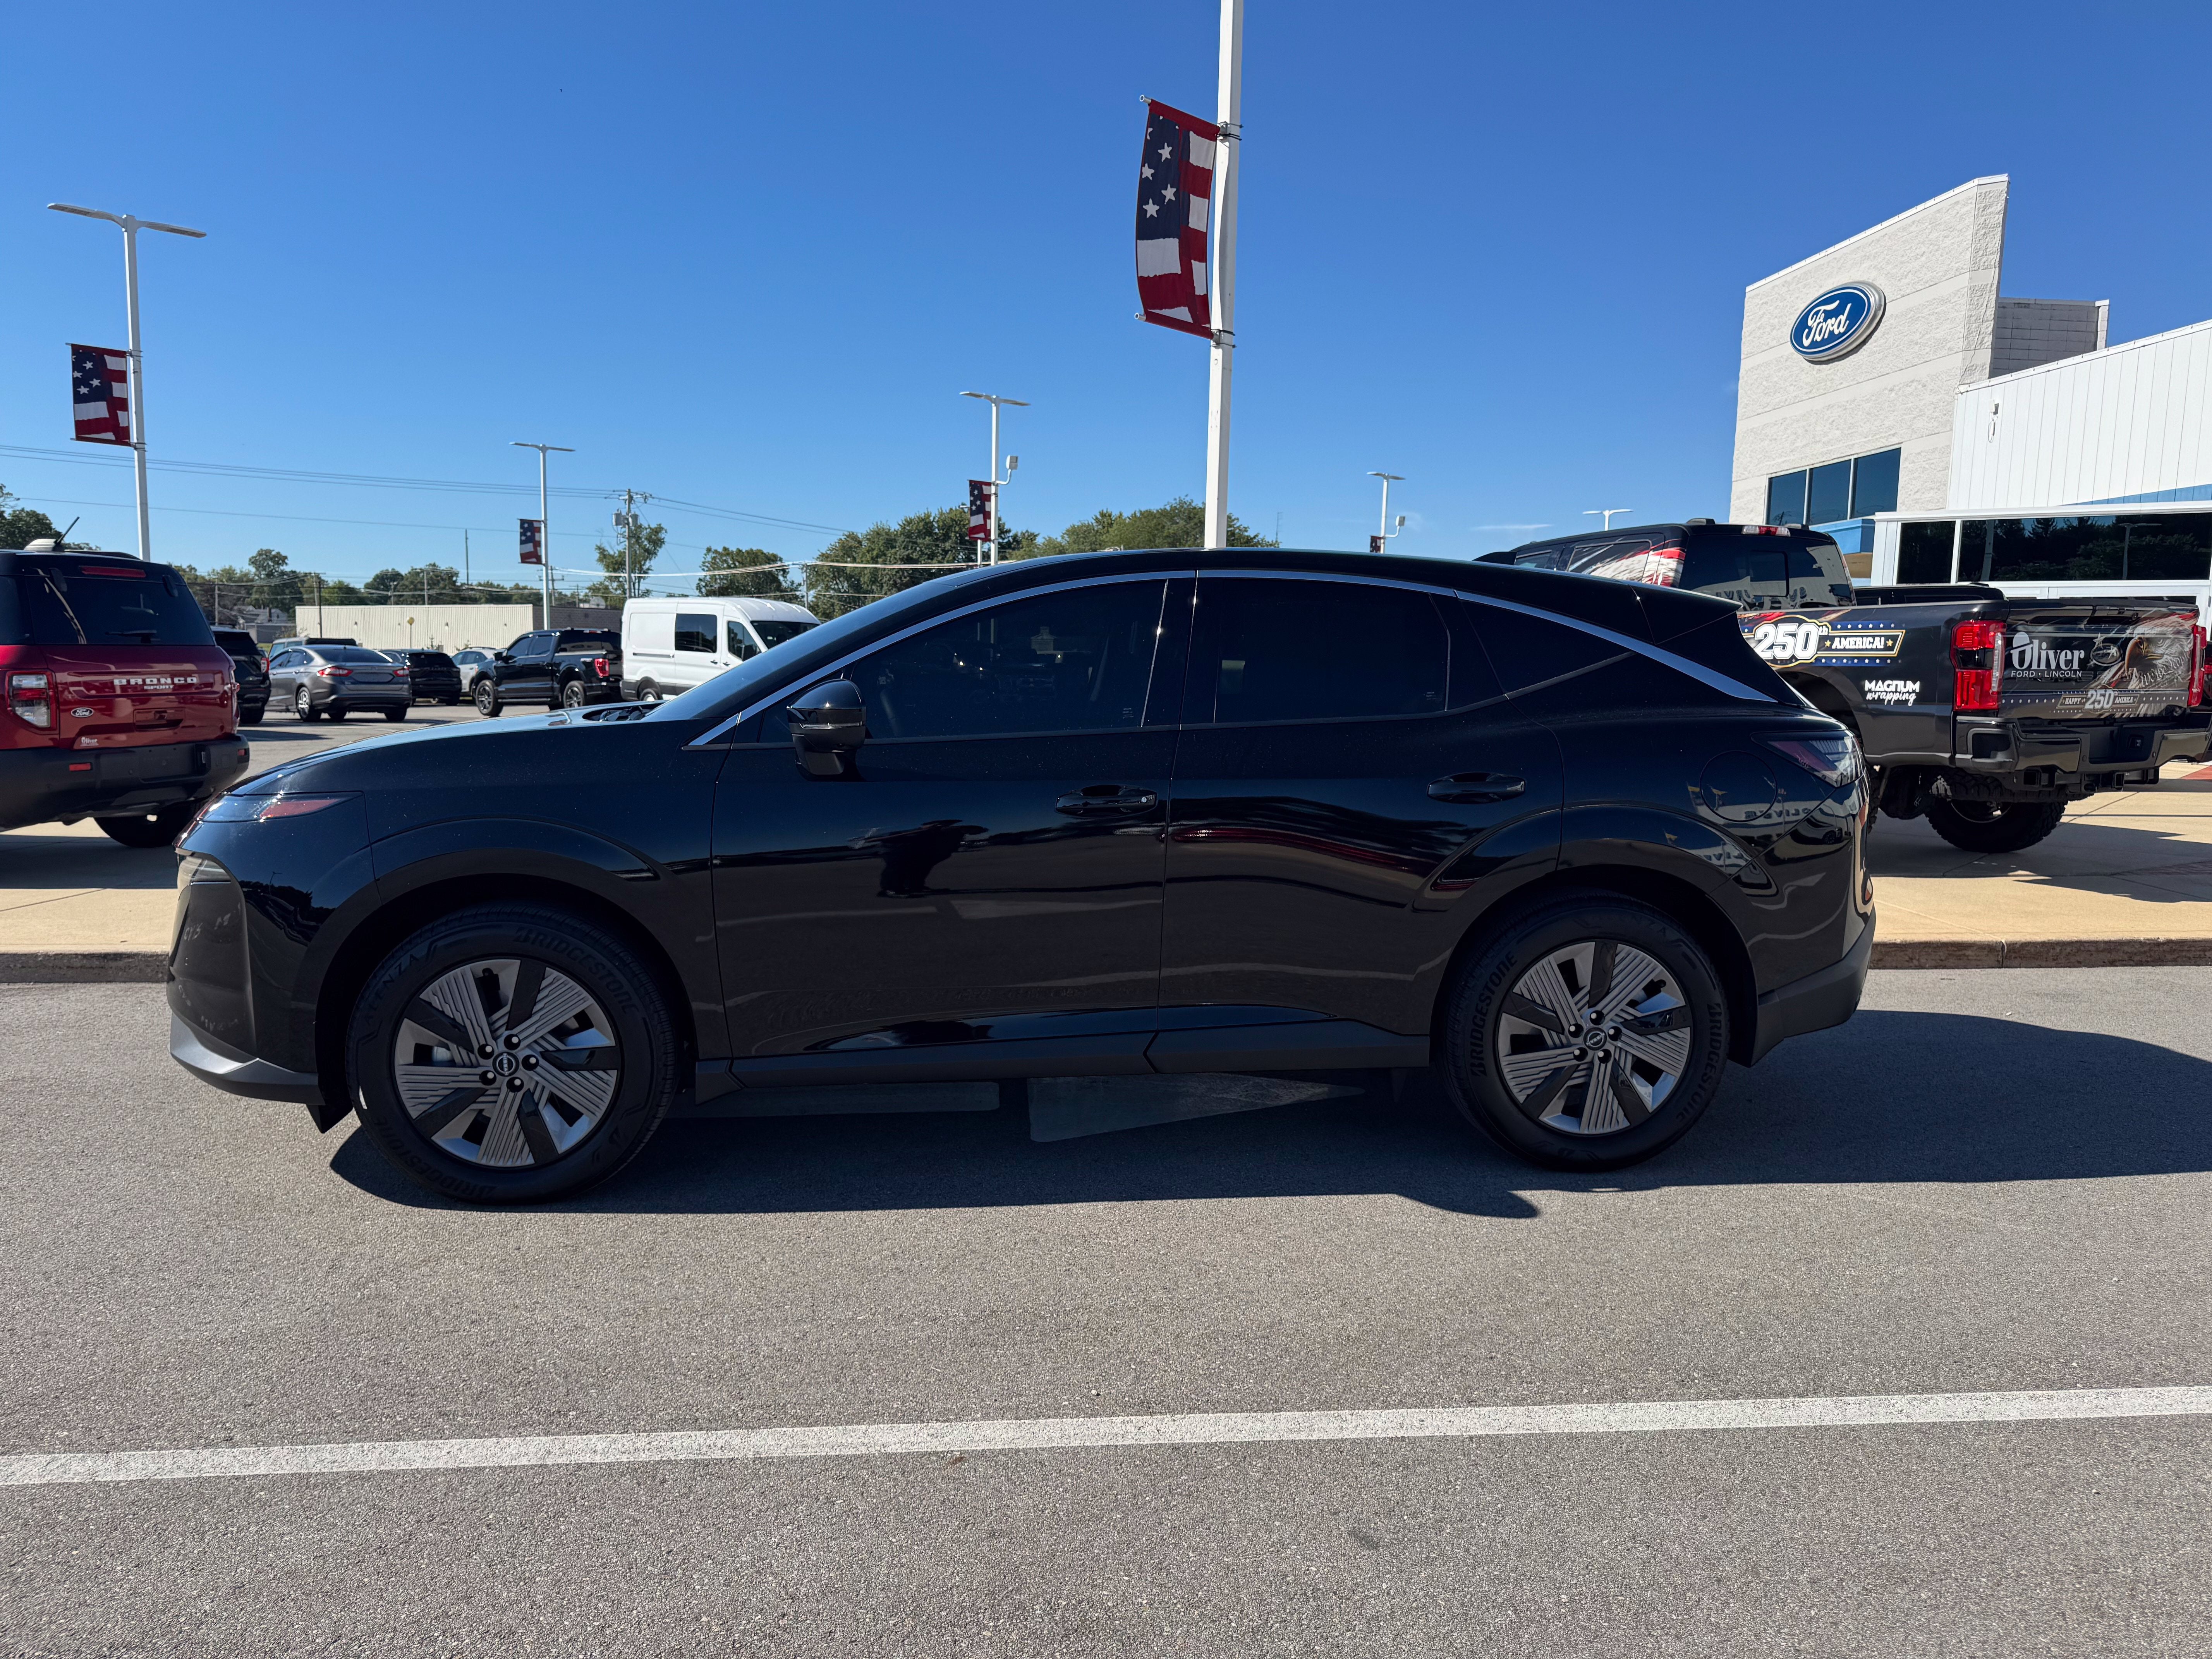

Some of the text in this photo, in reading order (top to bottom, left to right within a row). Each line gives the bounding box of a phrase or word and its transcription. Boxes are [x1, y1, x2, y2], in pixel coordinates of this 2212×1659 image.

[1802, 299, 1852, 347] Ford
[1831, 637, 1885, 649] AMERICA!
[2010, 632, 2085, 670] Oliver
[113, 677, 197, 685] BRONCO
[1864, 680, 1920, 692] MAGNUM
[1866, 691, 1917, 707] wrapping
[514, 927, 639, 1015] BRIDGESTONE
[1470, 951, 1518, 1077] BRIDGESTONE
[1676, 1002, 1724, 1123] BRIDGESTONE
